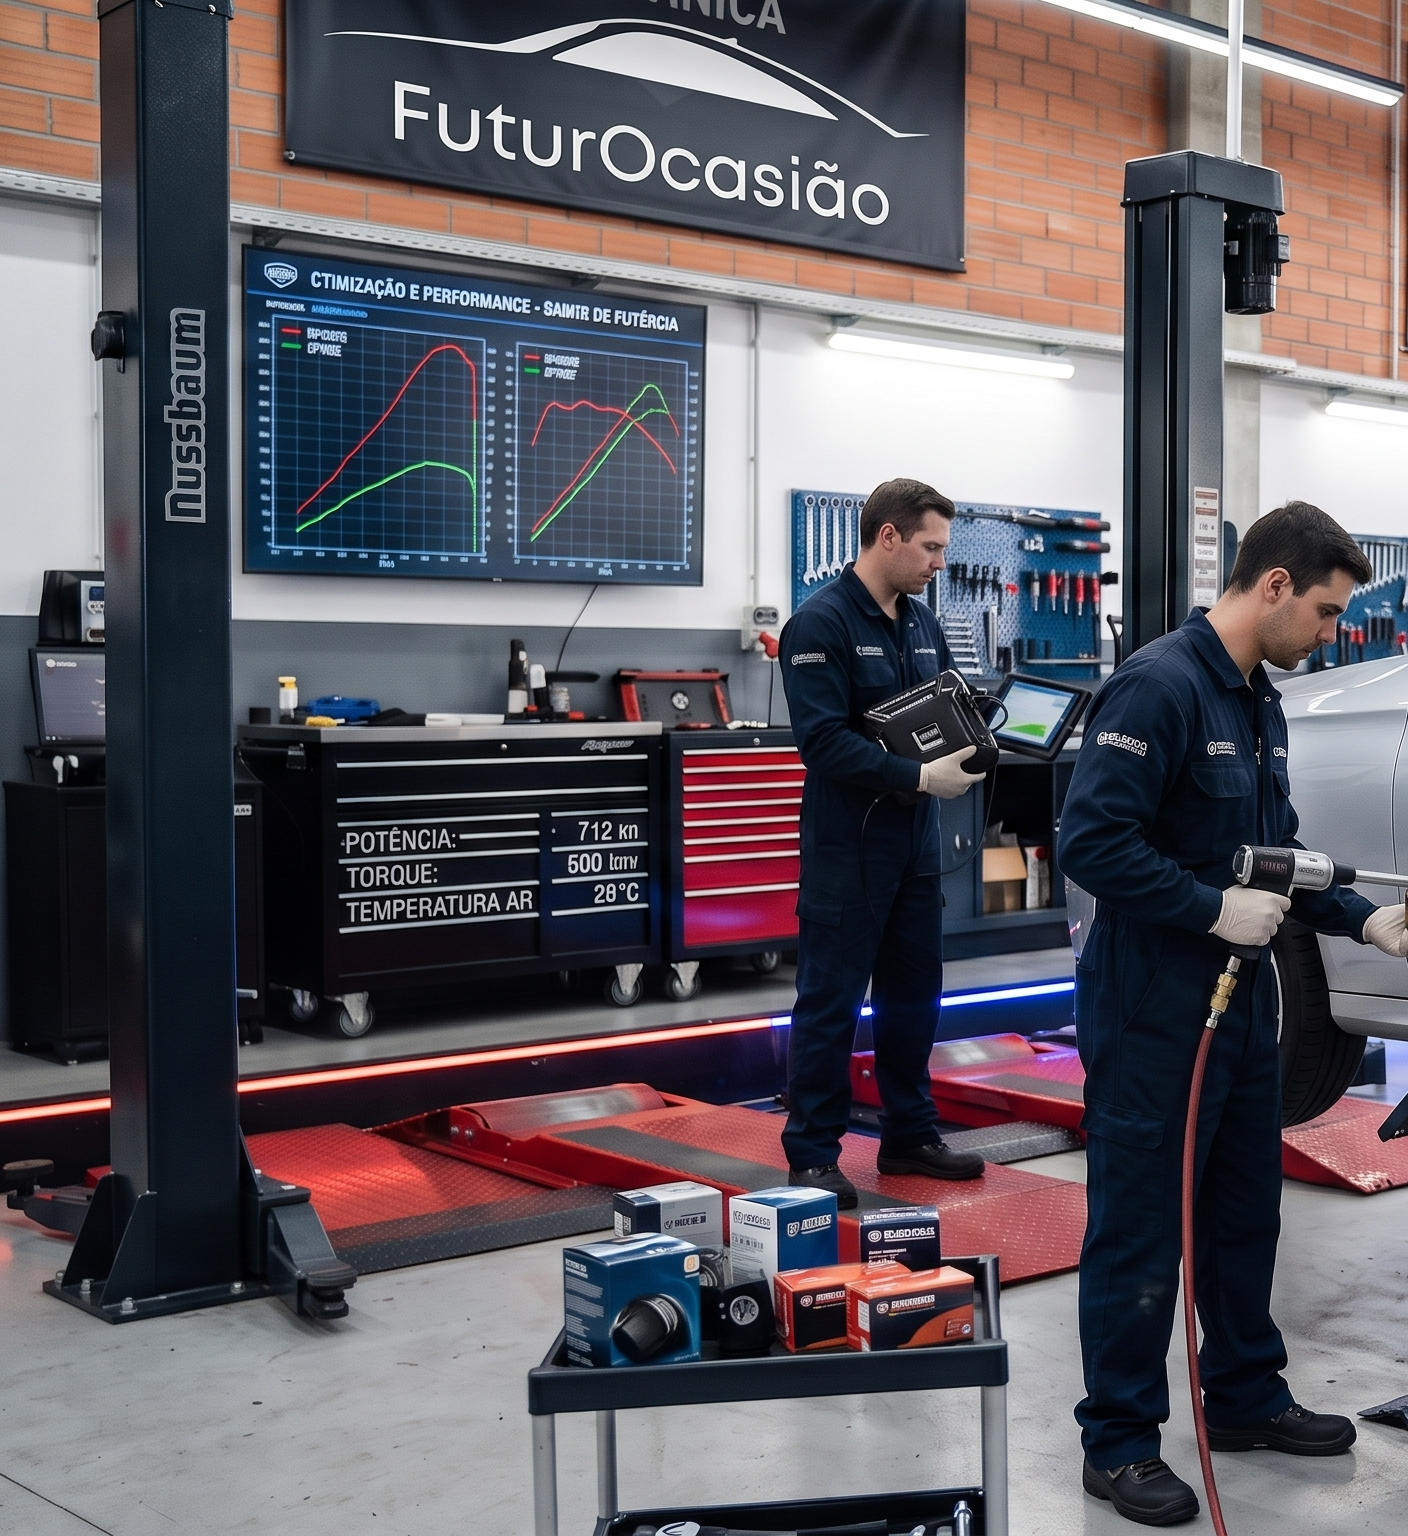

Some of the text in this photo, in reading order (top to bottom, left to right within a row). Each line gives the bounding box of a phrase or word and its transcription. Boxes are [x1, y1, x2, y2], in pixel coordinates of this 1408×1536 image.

[394, 80, 890, 226] FuturOcasião
[409, 284, 420, 300] E
[423, 285, 531, 313] PERFORMANCE
[593, 308, 611, 324] DE
[614, 309, 679, 332] FUTÉRCIA
[164, 307, 206, 524] Nussbaum
[345, 826, 457, 854] POTÊNCIA:
[578, 820, 613, 841] 712
[346, 863, 438, 888] TORQUE:
[567, 852, 603, 874] 500
[346, 889, 533, 923] TEMPERATURA AR
